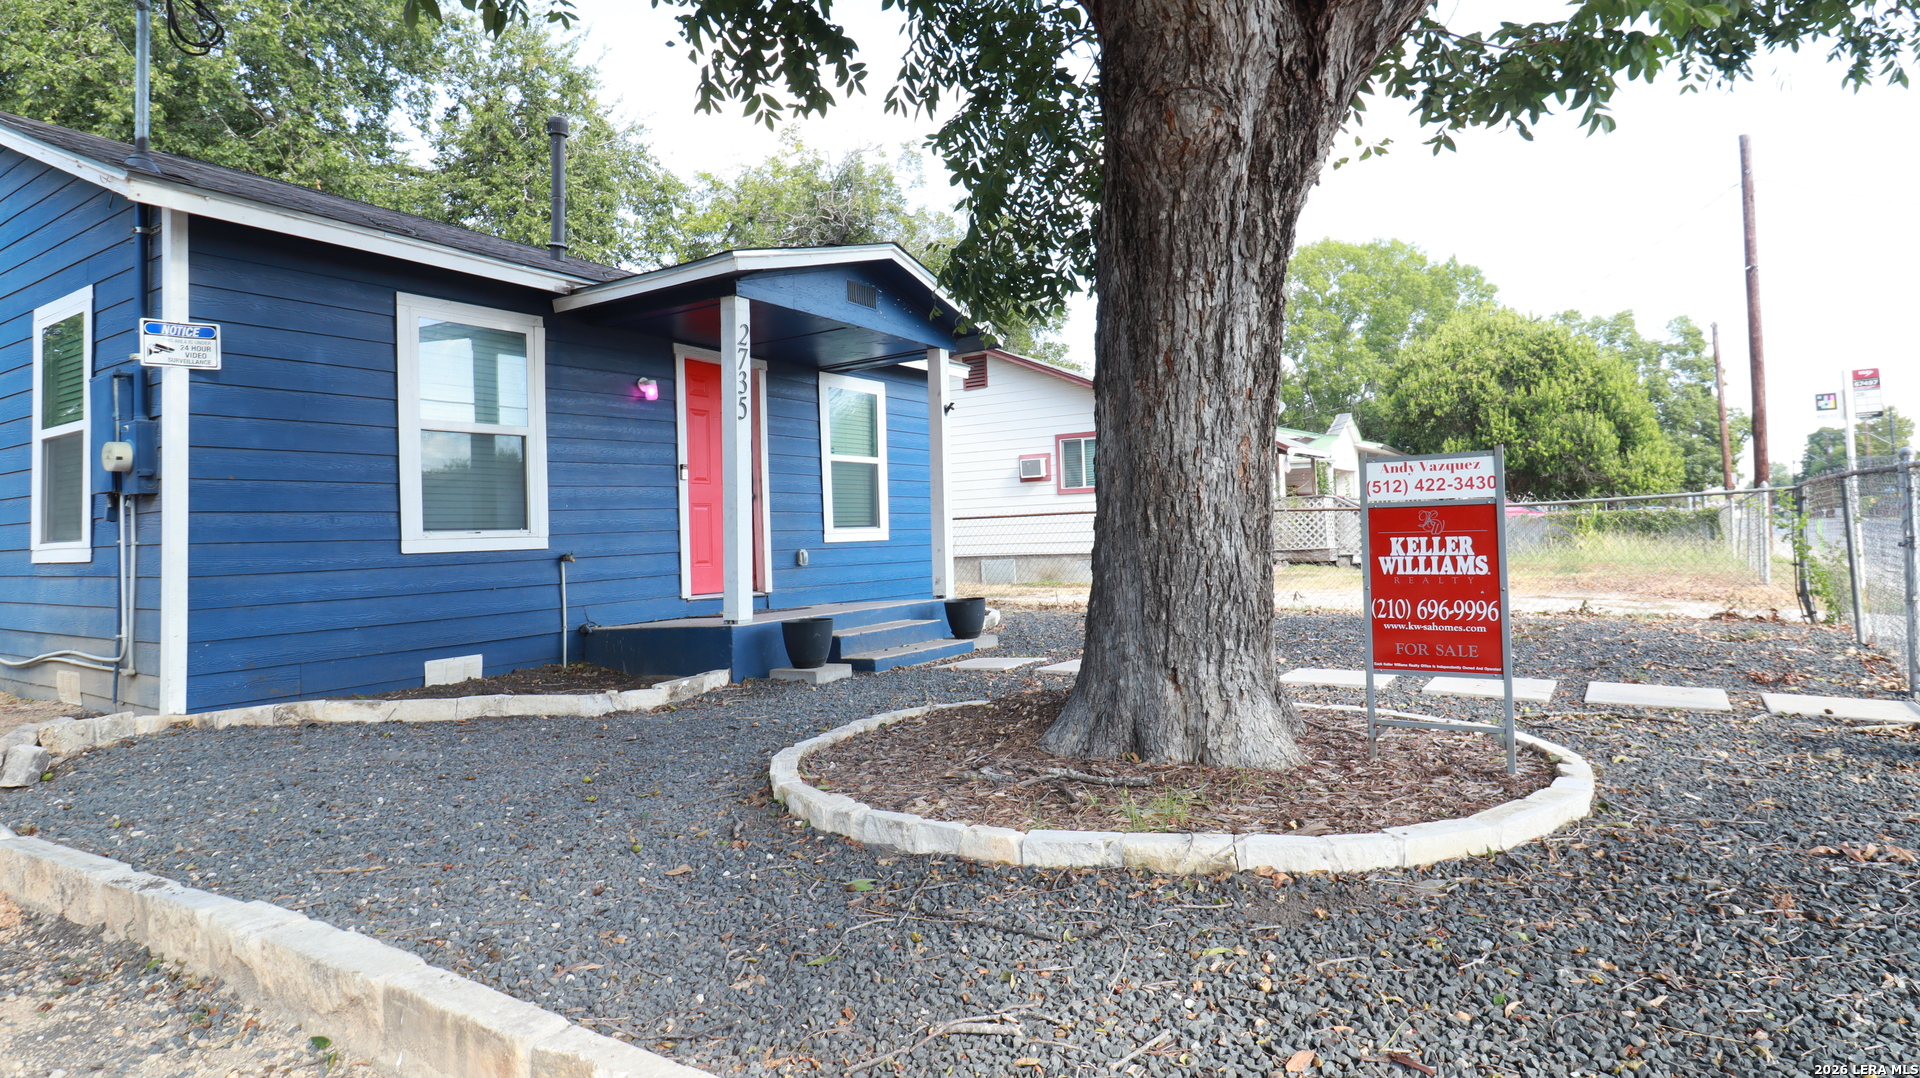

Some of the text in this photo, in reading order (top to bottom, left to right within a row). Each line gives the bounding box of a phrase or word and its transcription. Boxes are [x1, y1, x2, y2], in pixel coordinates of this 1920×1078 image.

[161, 324, 200, 337] NOTICE
[168, 357, 212, 365] SURVEILLANCE
[737, 324, 750, 421] 2735
[1381, 461, 1481, 475] Andy Vazquez
[1366, 475, 1497, 497] (512) 422-3430
[1389, 536, 1475, 556] KELLER
[1378, 555, 1489, 575] WILLIAMS
[1371, 598, 1499, 622] (210) 696-9996
[1395, 643, 1479, 658] FOR SALE
